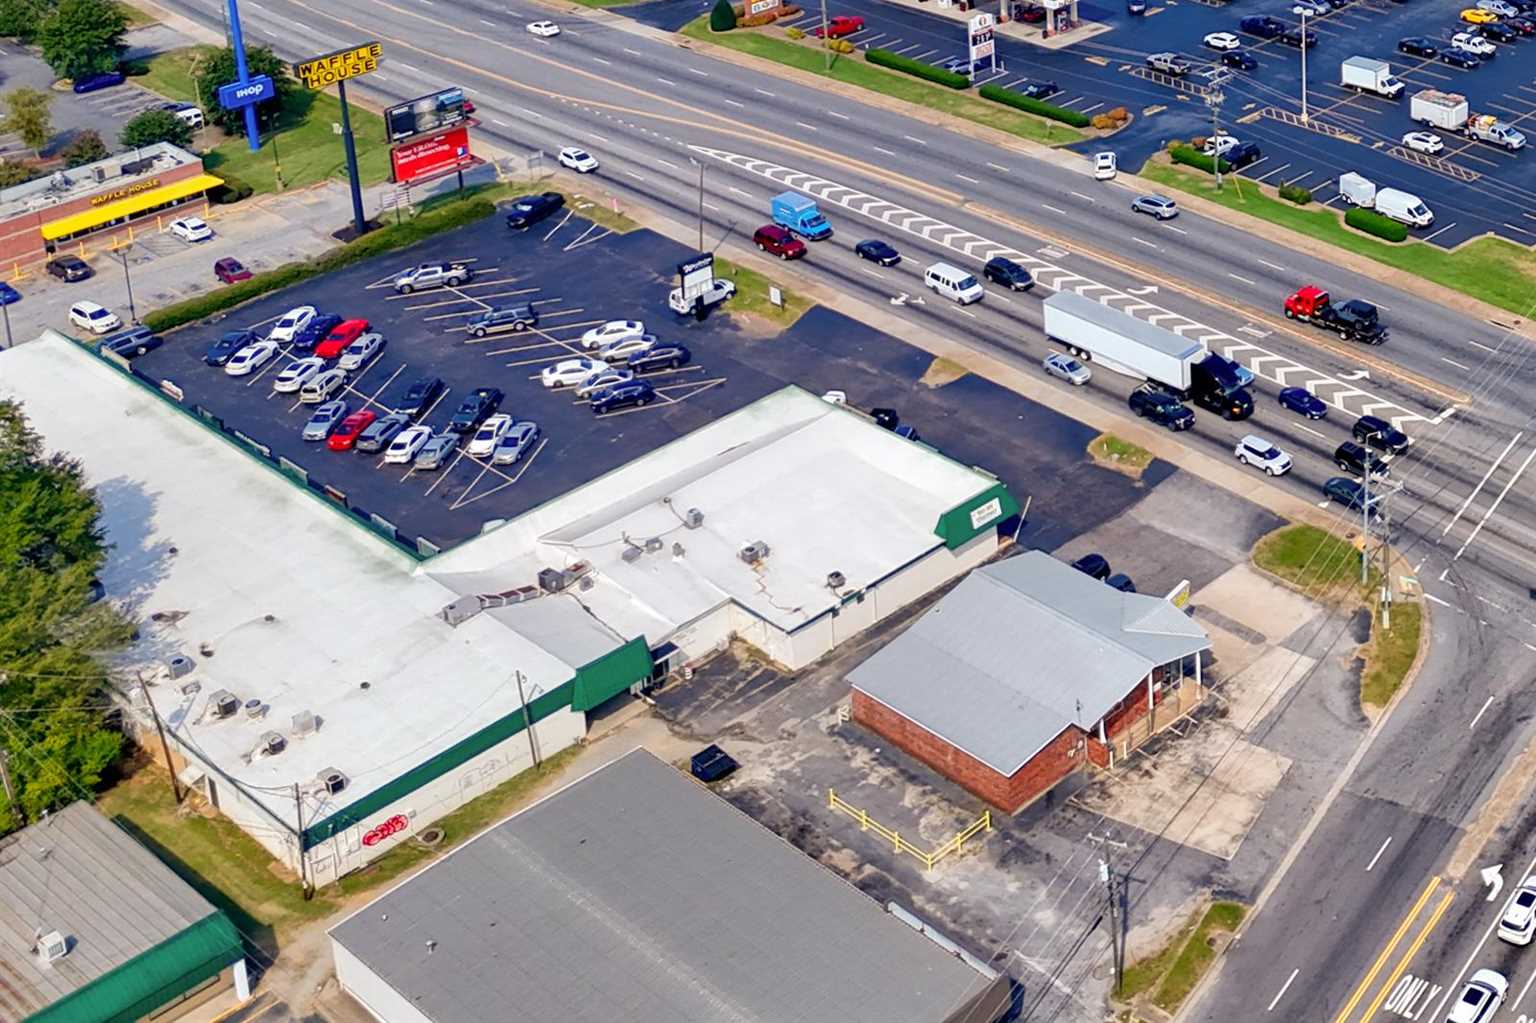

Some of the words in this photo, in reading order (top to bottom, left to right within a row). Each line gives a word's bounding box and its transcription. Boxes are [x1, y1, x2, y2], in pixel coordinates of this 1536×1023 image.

[301, 44, 379, 75] WAFFLE
[310, 60, 374, 86] HOUSE
[128, 178, 160, 193] HOUSE
[1384, 974, 1443, 1021] ONLY
